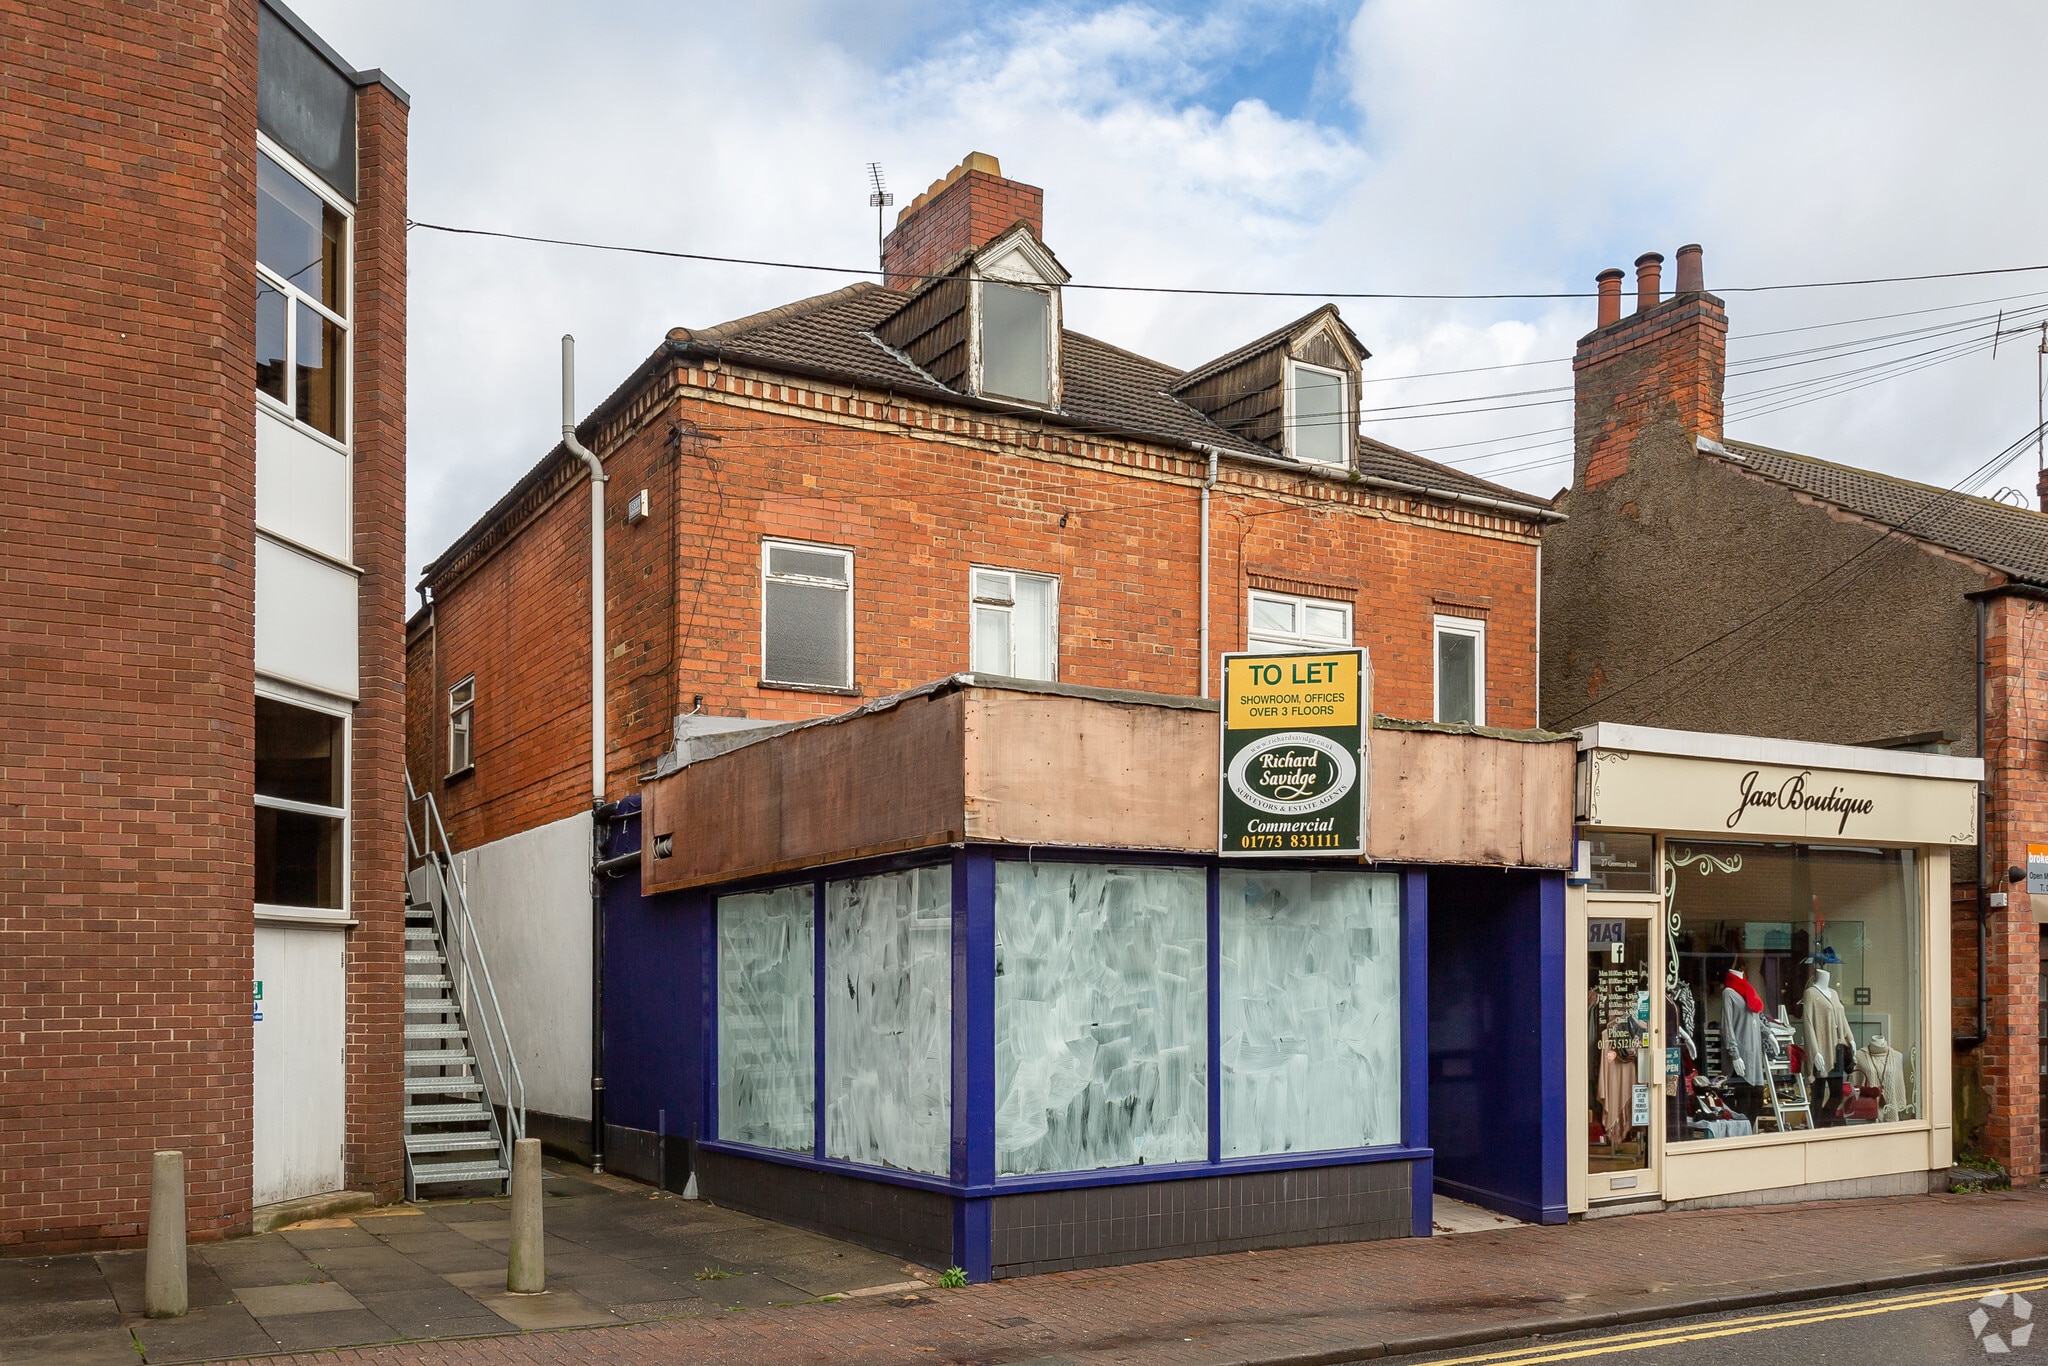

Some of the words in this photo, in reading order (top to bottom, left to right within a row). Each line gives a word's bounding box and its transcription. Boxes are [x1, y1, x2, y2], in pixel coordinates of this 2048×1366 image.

[1248, 664, 1283, 686] TO
[1291, 662, 1339, 684] LET
[1240, 694, 1301, 706] SHOWROOM,
[1304, 692, 1345, 703] OFFICES
[1249, 707, 1278, 717] OVER
[1281, 707, 1288, 716] 3
[1291, 705, 1334, 716] FLOORS
[1250, 733, 1334, 753] www.richardsavidge.co.uk
[1259, 750, 1319, 768] Richard
[1259, 768, 1317, 800] Savidge
[1236, 787, 1278, 811] SURVEYORS
[1288, 801, 1318, 812] ESTATE
[1319, 784, 1348, 806] AGENTS
[1726, 770, 1778, 829] Jax
[1777, 771, 1874, 836] Boutique
[1247, 817, 1335, 833] Commercial
[1241, 834, 1283, 849] 01773
[1290, 833, 1340, 847] 831111
[2029, 872, 2043, 880] Open
